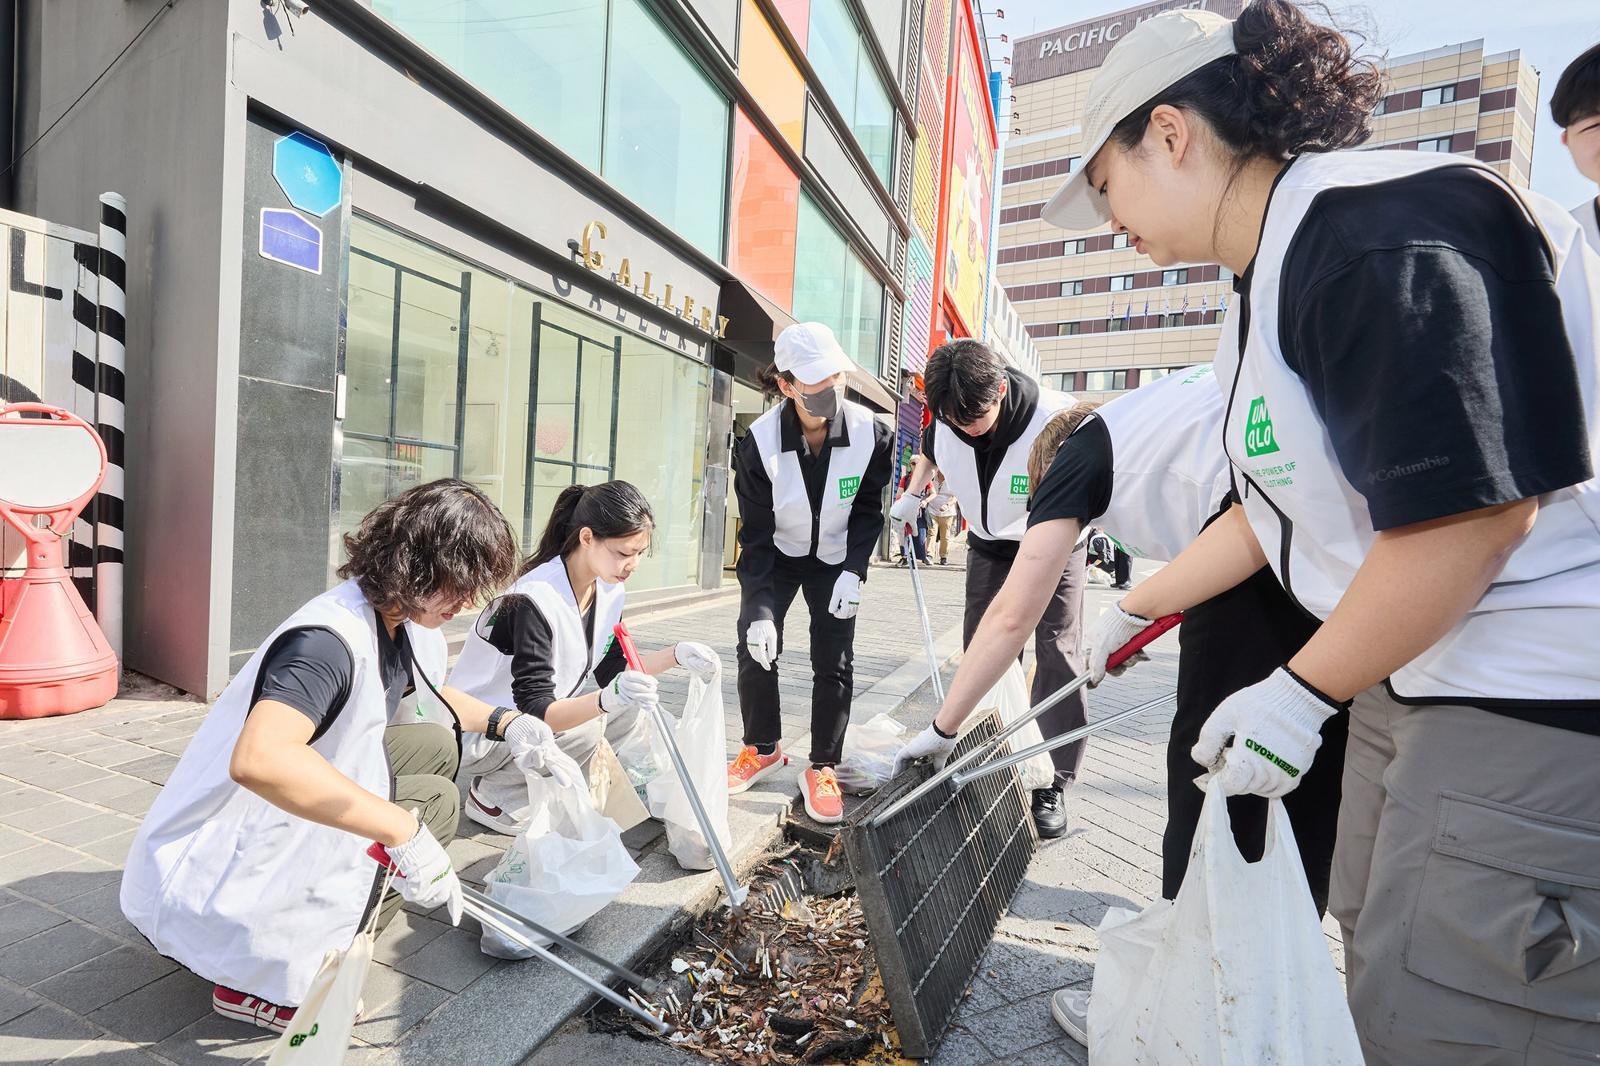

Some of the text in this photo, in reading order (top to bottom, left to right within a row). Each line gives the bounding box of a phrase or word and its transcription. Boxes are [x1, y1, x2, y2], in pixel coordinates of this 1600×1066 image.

[1039, 22, 1122, 59] PACIFIC
[582, 221, 730, 339] GALLERY
[1247, 425, 1271, 452] QLO
[1285, 461, 1296, 472] OF
[1375, 456, 1451, 481] Columbia
[841, 479, 857, 489] UNI
[1245, 738, 1300, 778] GREEN ROAD
